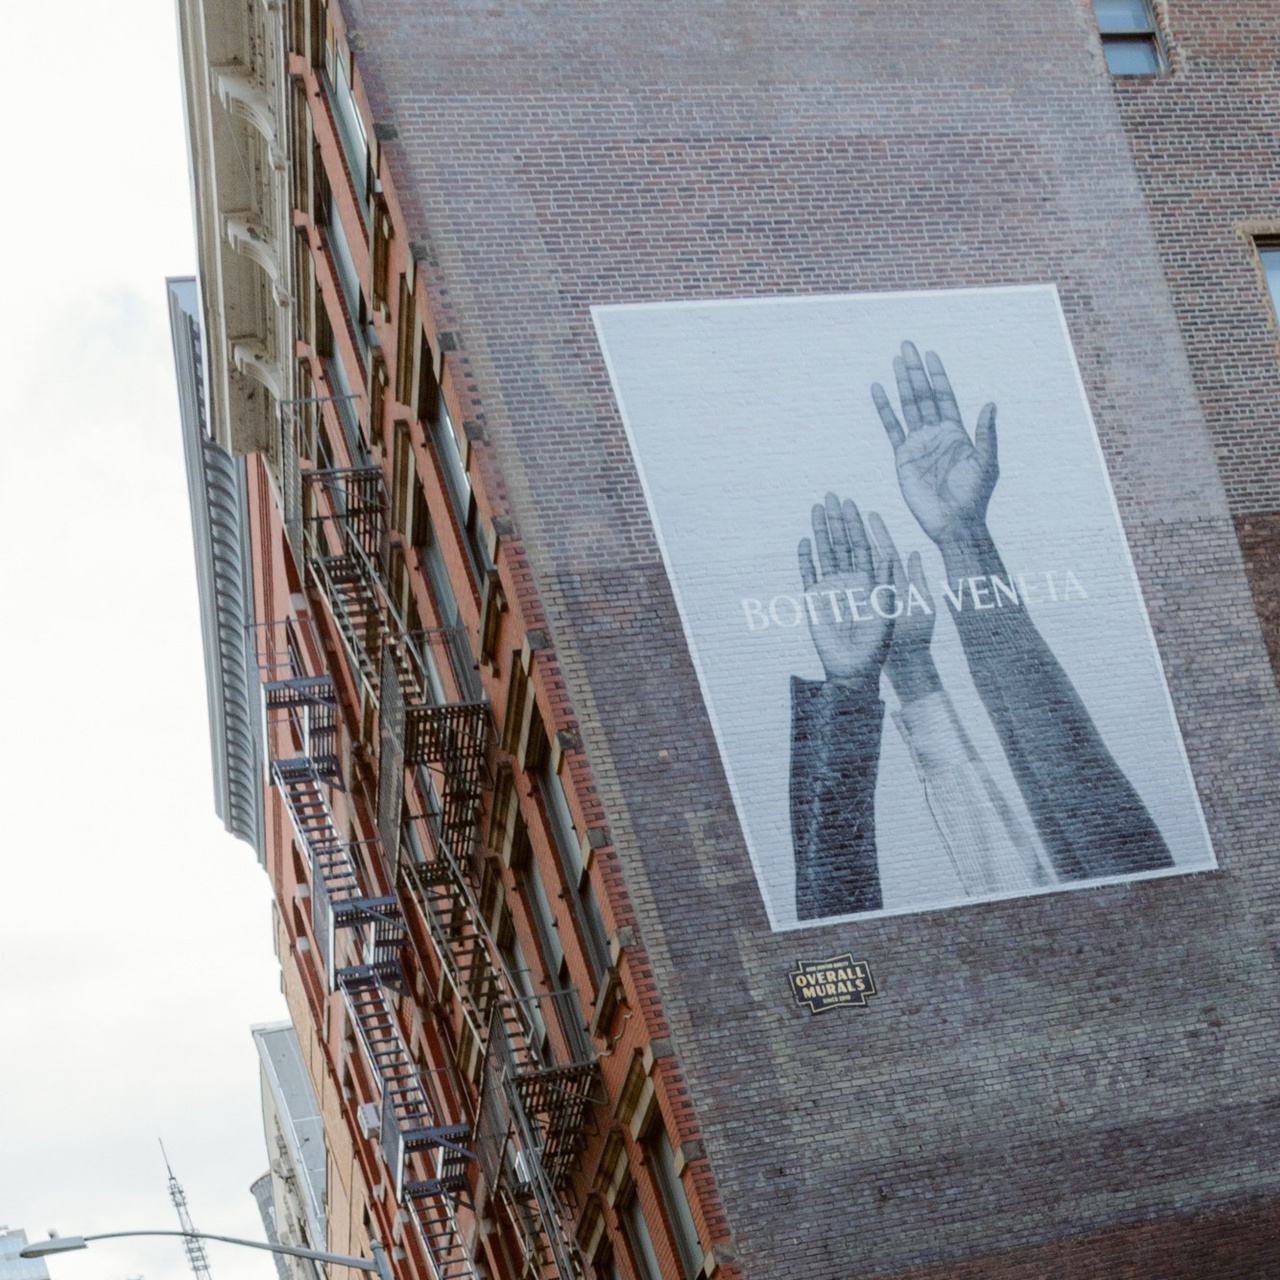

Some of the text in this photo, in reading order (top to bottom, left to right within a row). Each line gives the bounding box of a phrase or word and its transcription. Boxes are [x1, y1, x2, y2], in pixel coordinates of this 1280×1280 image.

[740, 569, 1090, 632] BOTTEGA VENETA
[795, 966, 866, 987] OVERALL
[802, 978, 866, 999] MURALS
